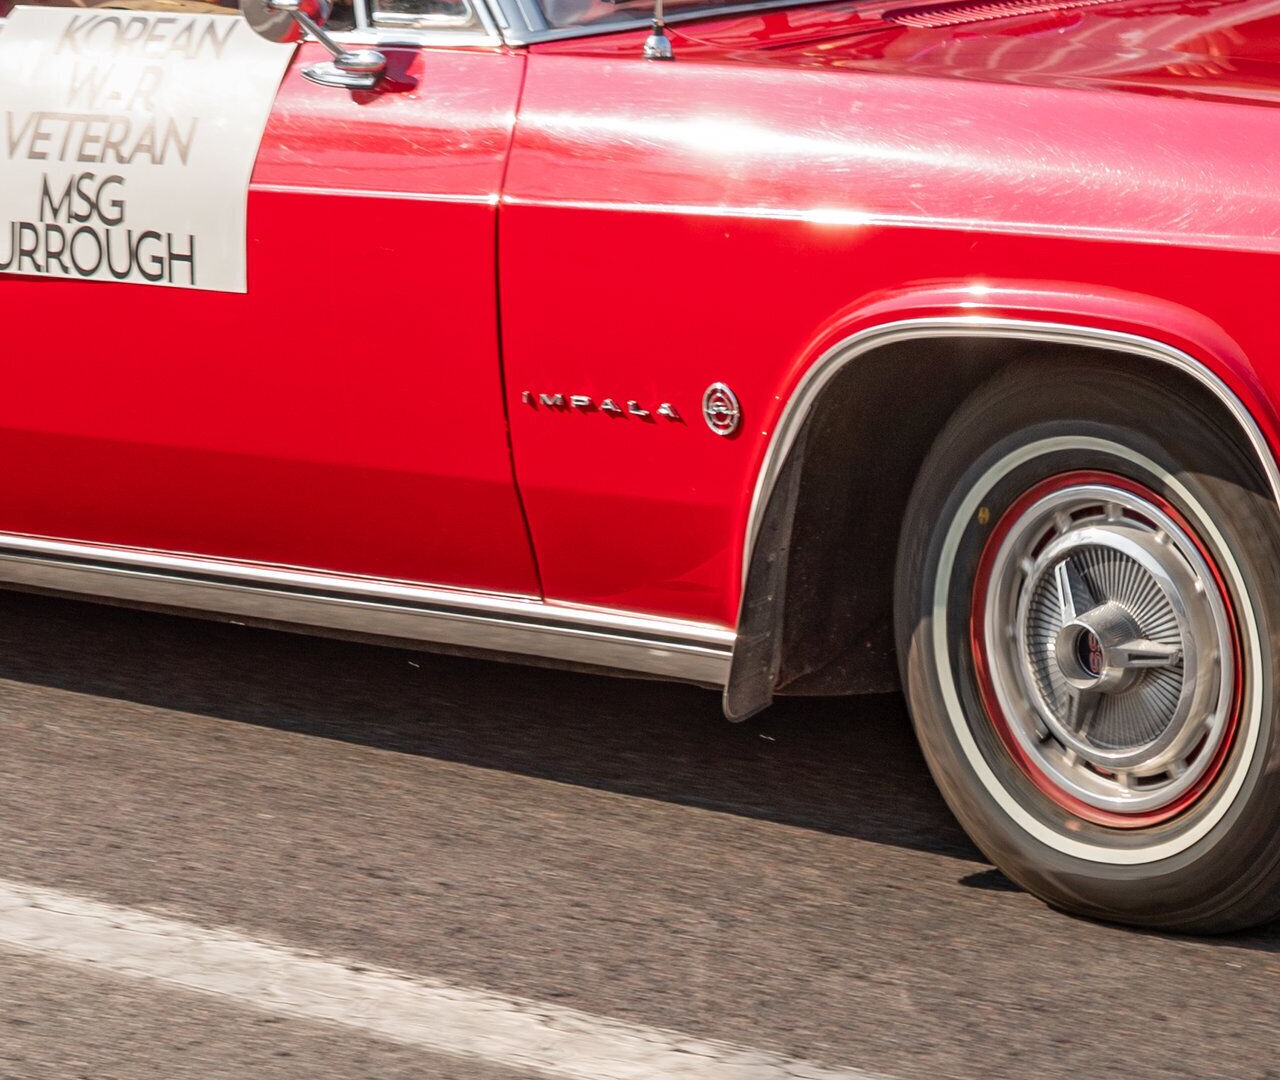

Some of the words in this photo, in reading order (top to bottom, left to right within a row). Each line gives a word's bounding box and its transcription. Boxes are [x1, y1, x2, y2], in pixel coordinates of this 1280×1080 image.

[54, 14, 242, 60] KOREAN
[65, 61, 166, 112] WR
[5, 111, 199, 167] VETERAN
[39, 172, 125, 227] MSG
[522, 390, 680, 419] IMPALA
